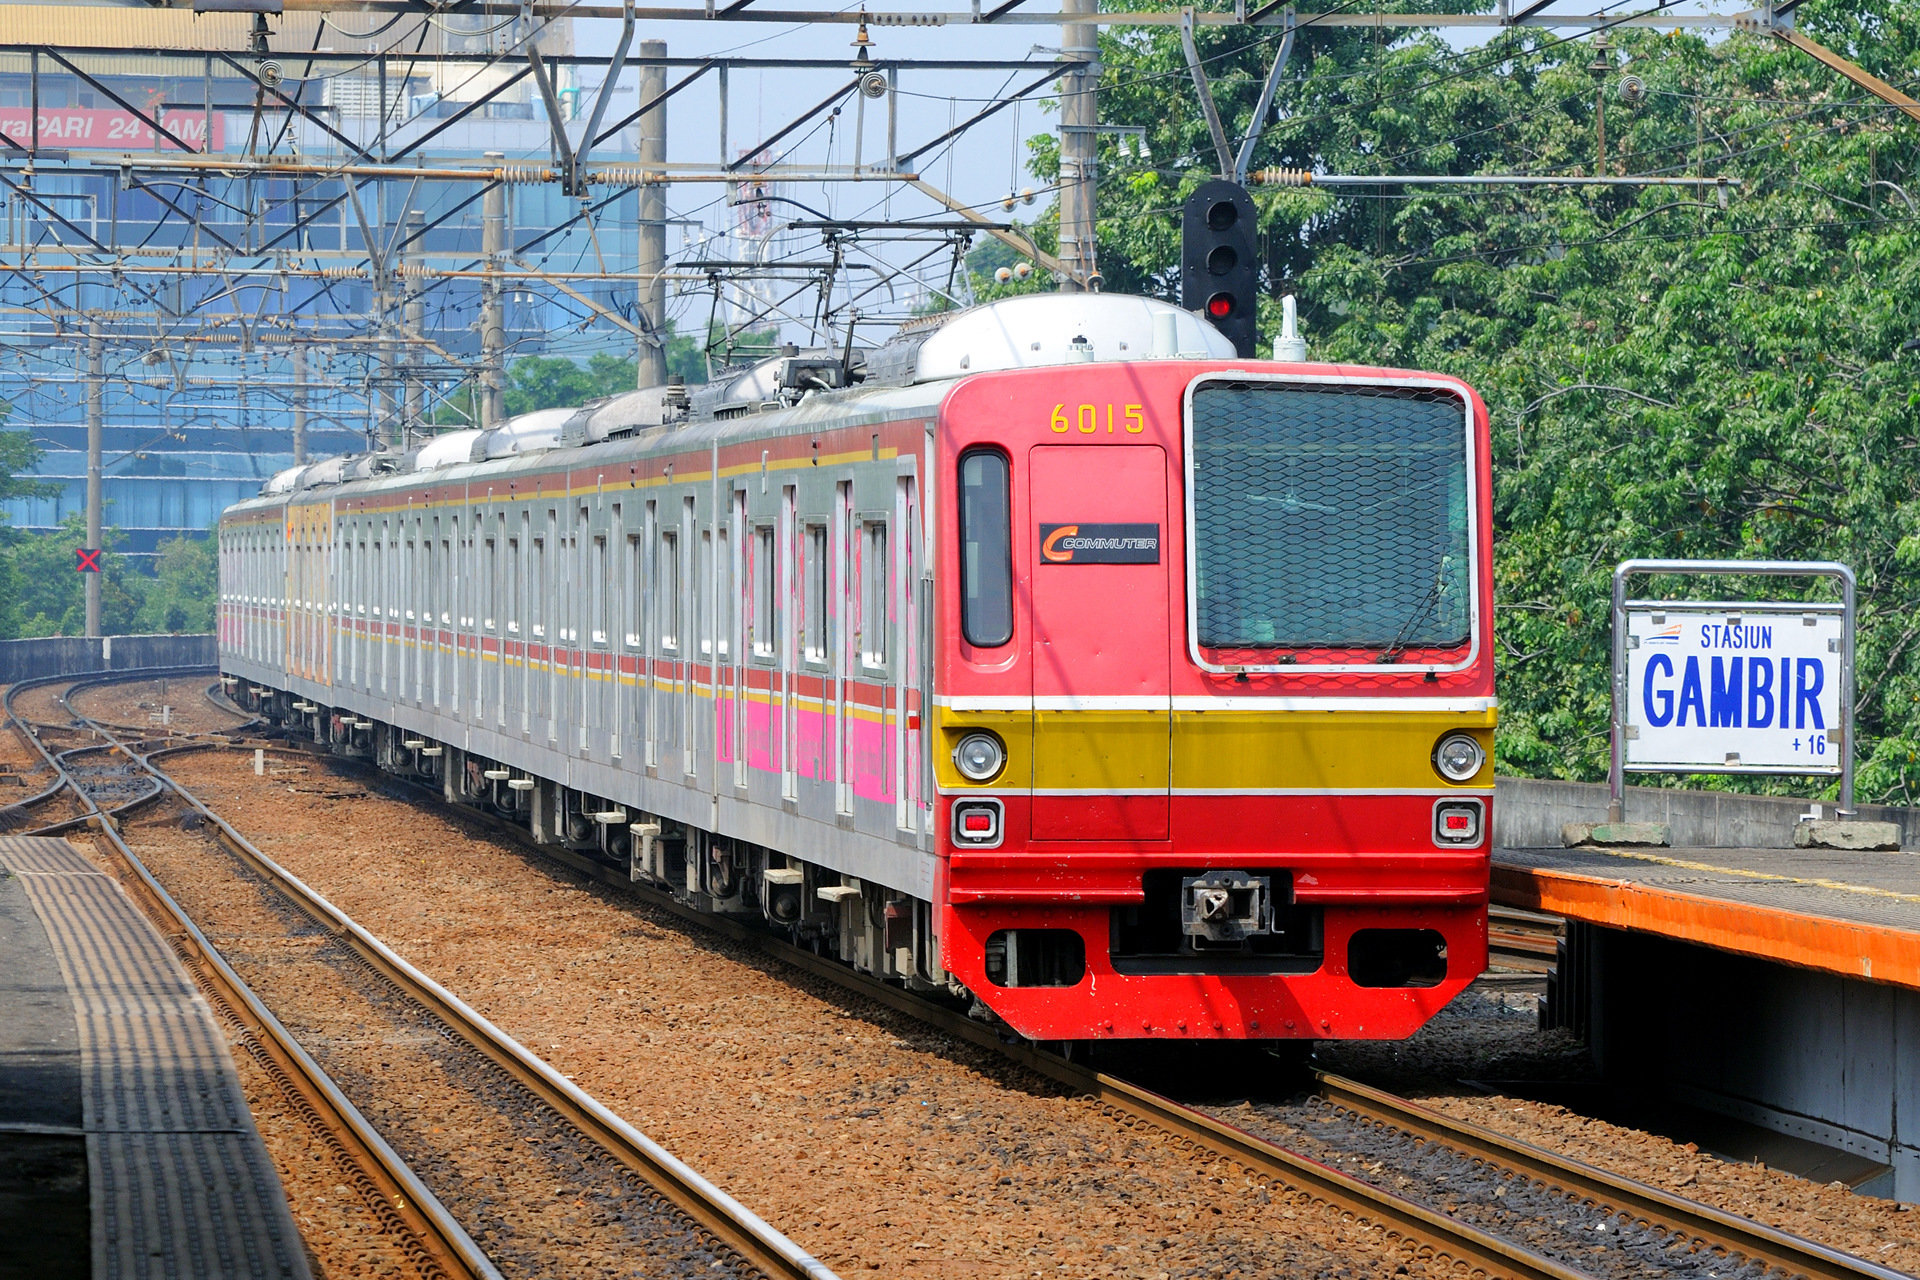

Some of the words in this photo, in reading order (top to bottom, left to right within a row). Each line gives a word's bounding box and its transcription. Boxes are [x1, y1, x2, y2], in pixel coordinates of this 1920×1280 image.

[107, 118, 140, 139] 24
[1051, 403, 1144, 433] 6015
[1063, 537, 1158, 550] COMMUTER
[1701, 624, 1772, 649] STASIUN
[1643, 653, 1826, 730] GAMBIR
